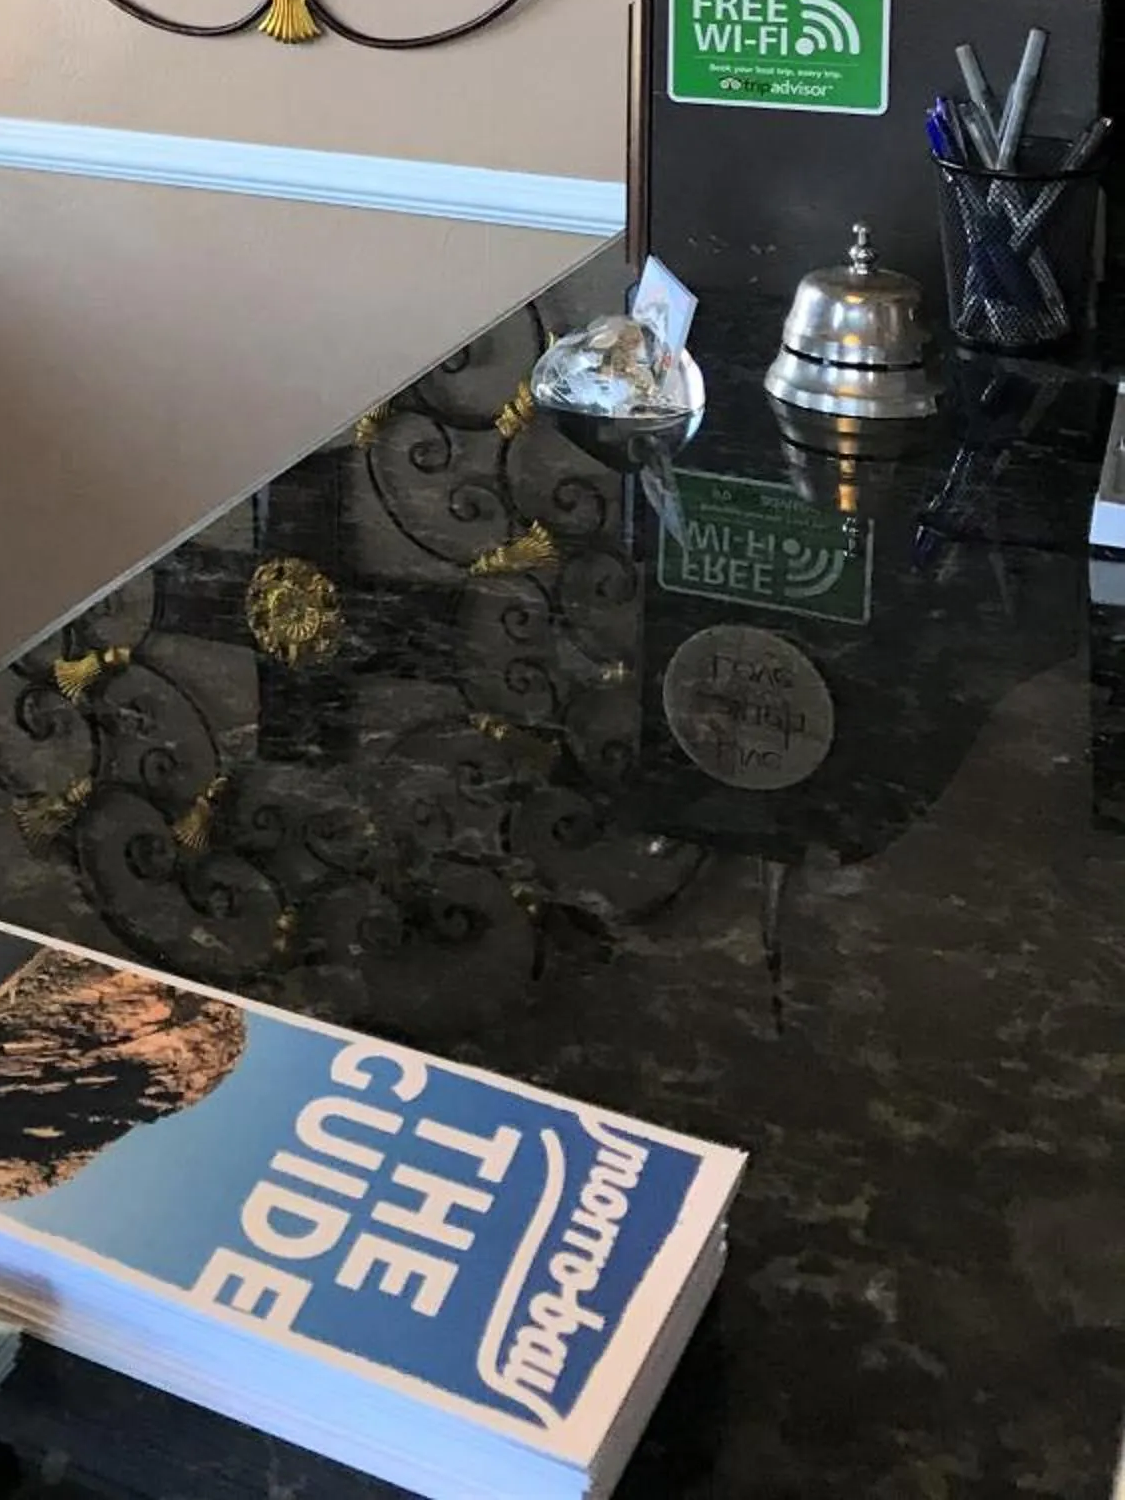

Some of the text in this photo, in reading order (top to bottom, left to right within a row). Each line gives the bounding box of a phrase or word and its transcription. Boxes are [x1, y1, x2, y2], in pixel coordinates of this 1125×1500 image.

[693, 22, 788, 56] WI-FI
[187, 1041, 429, 1336] GUIDE
[335, 1117, 522, 1318] THE
